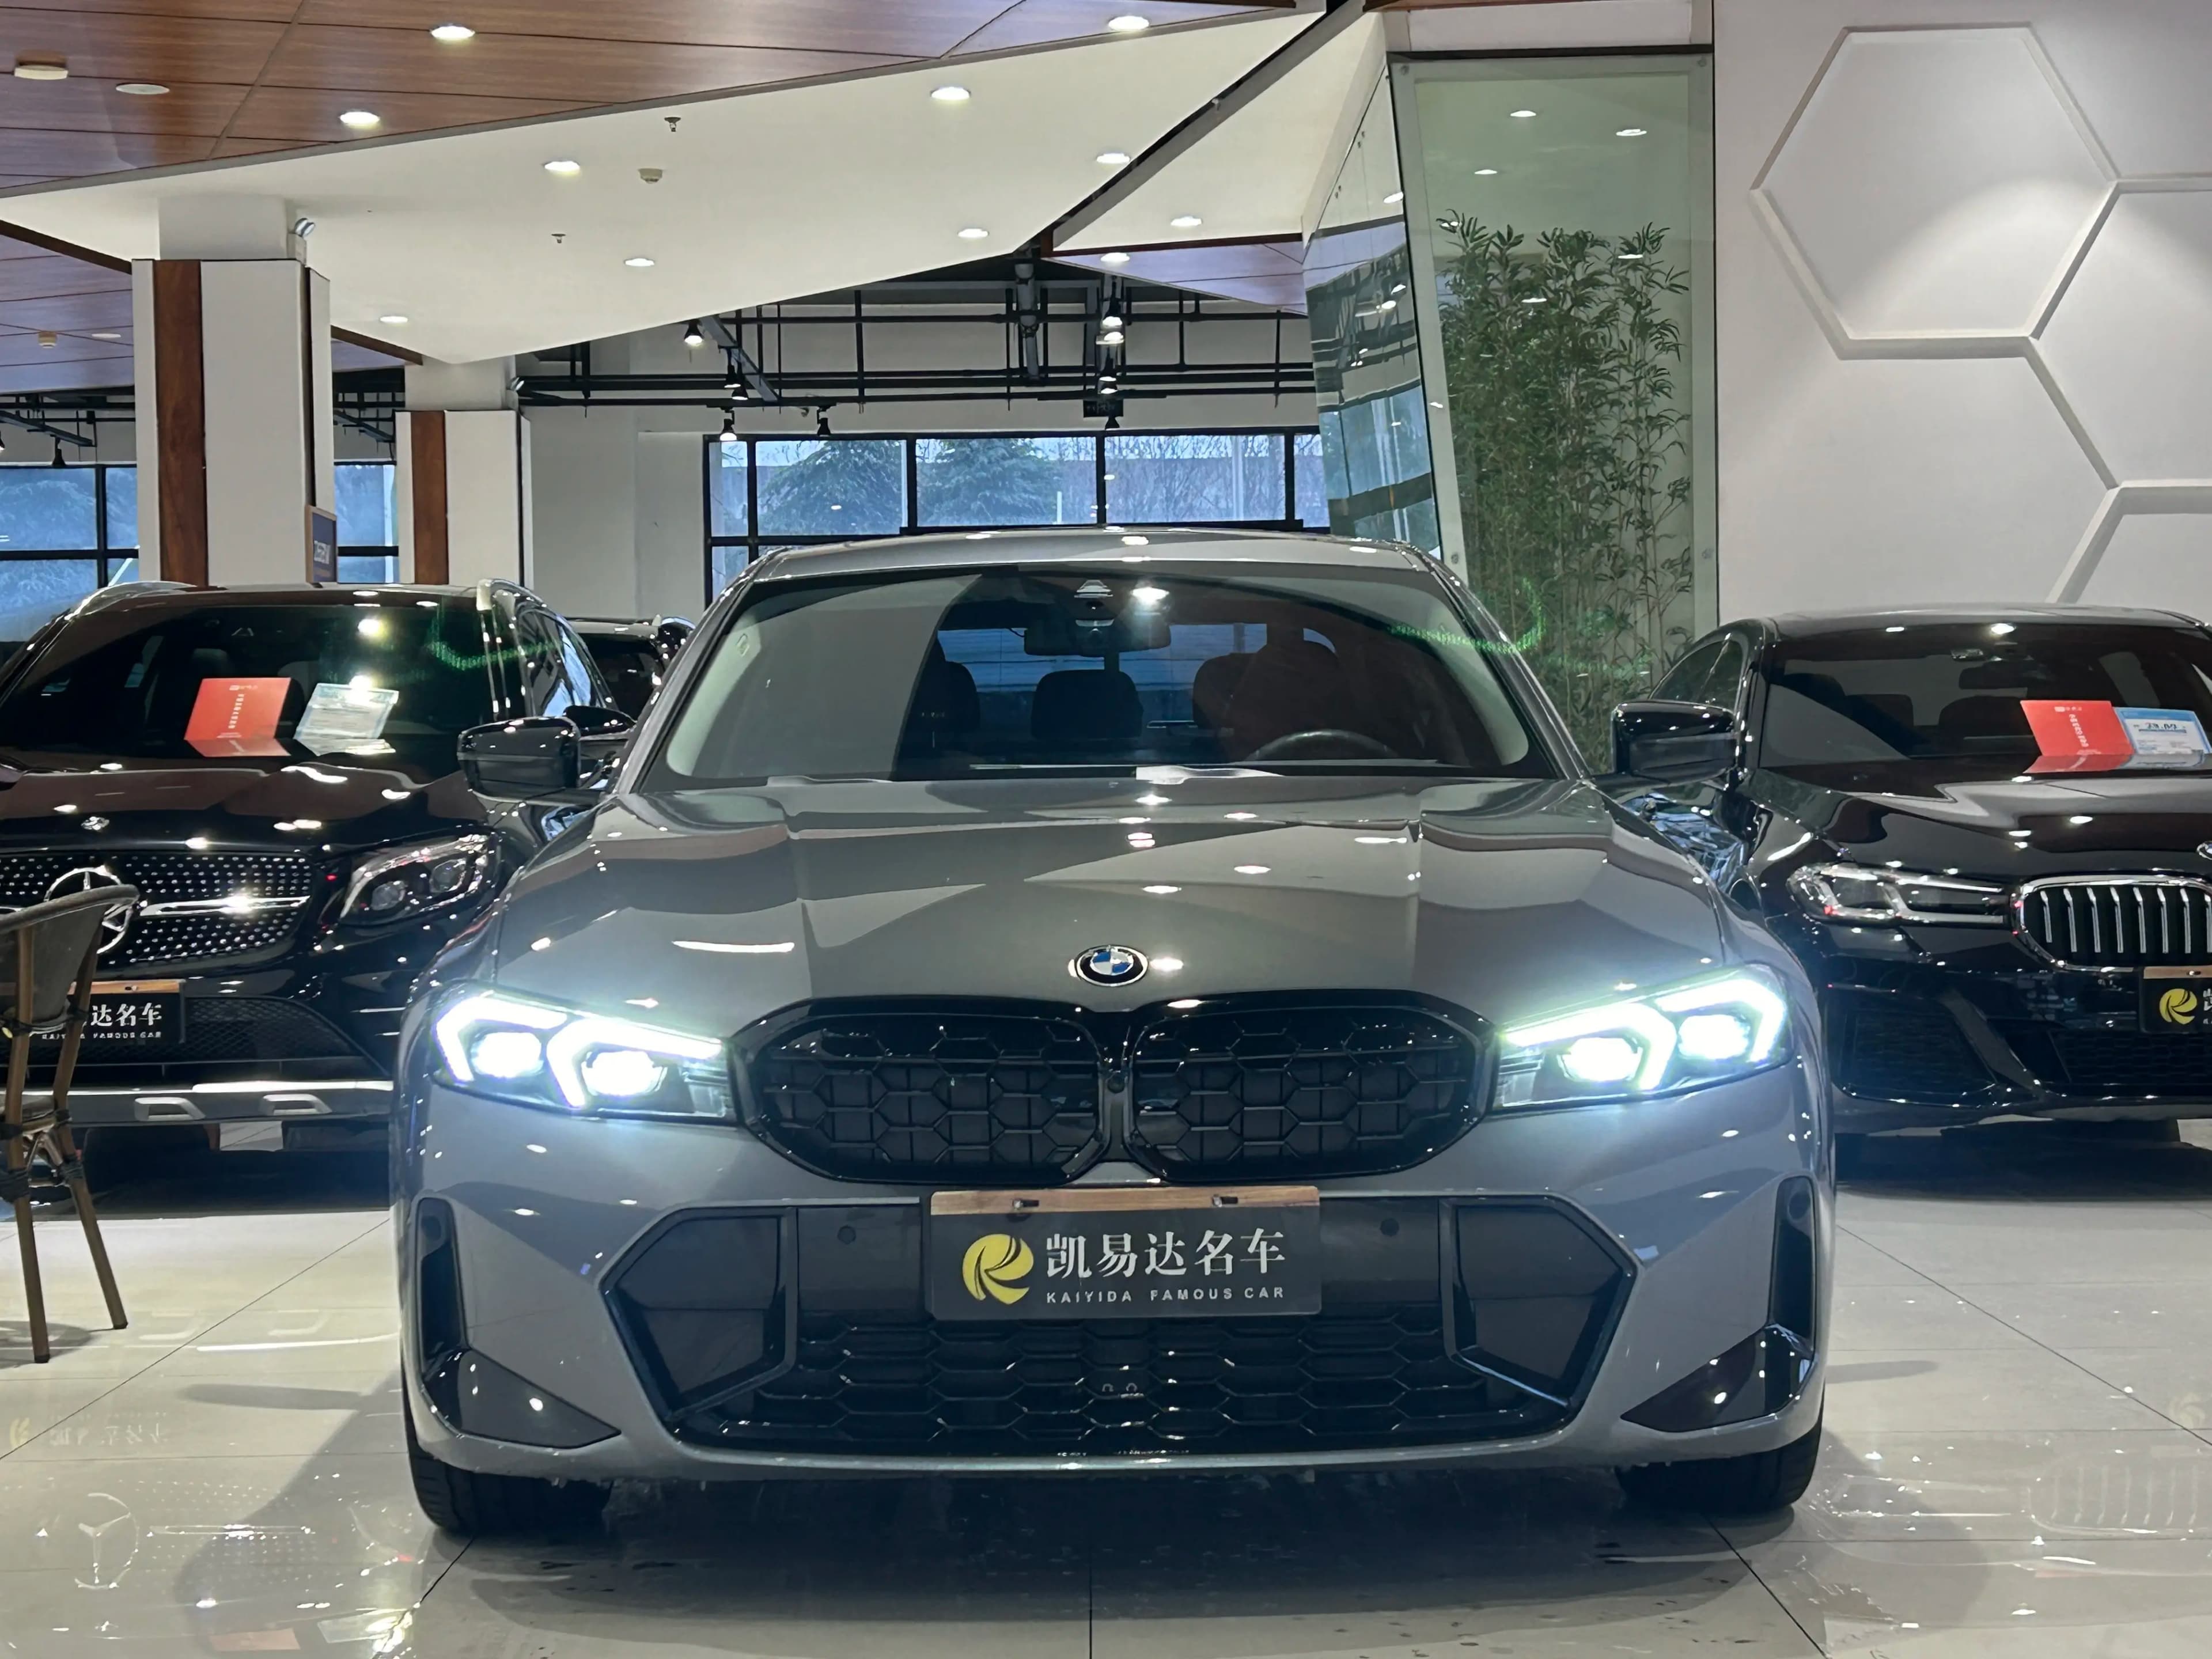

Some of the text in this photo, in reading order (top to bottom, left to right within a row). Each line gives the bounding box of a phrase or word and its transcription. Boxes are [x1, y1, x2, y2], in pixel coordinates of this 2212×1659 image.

[82, 1002, 162, 1027] 达名车
[1046, 1228, 1285, 1278] 凯易达名车
[1046, 1286, 1284, 1304] KAIYIDA FAMOUS CAR
